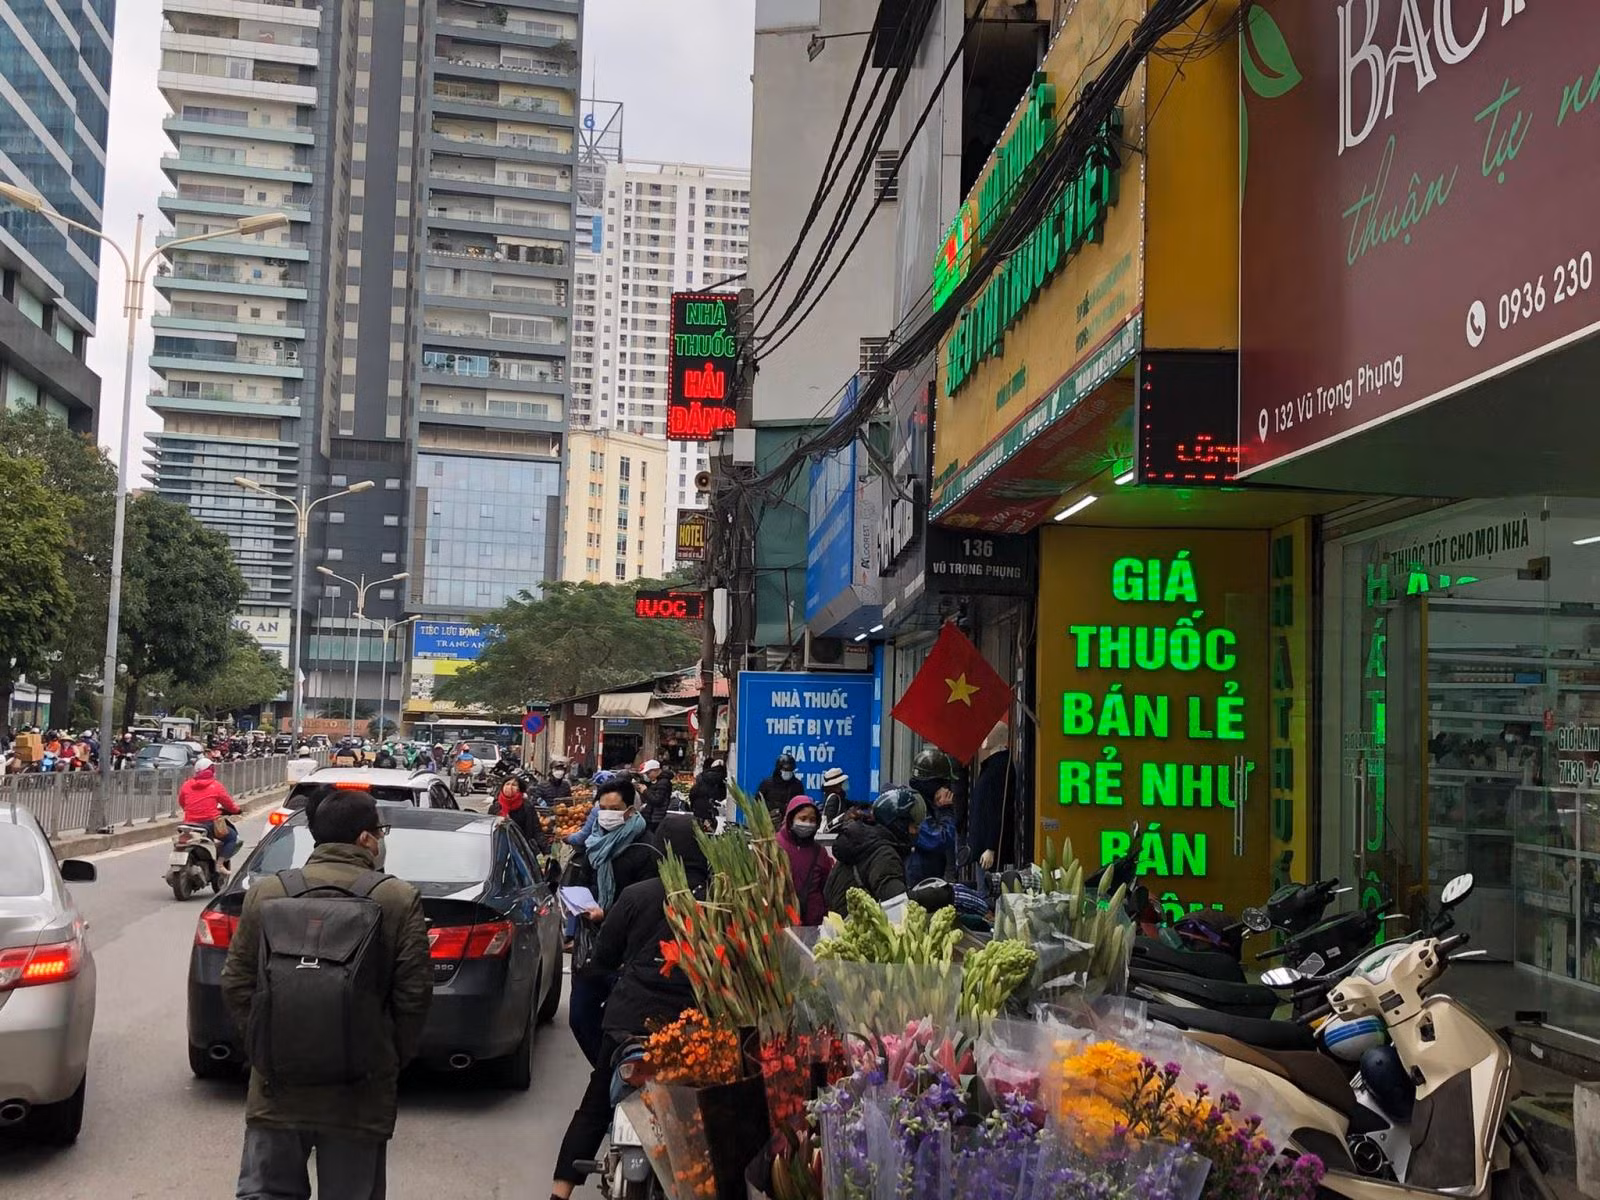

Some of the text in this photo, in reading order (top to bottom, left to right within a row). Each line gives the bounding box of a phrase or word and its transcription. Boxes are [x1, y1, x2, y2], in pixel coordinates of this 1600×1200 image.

[1337, 0, 1525, 156] BAC
[1343, 135, 1458, 265] thuận
[1499, 251, 1593, 329] 0936 230
[685, 300, 728, 326] NHÀ
[674, 328, 736, 357] THUỐC
[685, 362, 725, 398] HẢI
[1275, 354, 1403, 433] 132 Vũ Trọng Phụng
[671, 402, 736, 435] ĐĂNG
[678, 524, 705, 547] HOTEL
[962, 539, 993, 557] 136
[1391, 511, 1529, 576] THUỐC TỐT CHO MỌI NHÀ
[949, 563, 983, 576] TRỌNG
[985, 565, 1021, 580] PHỤNG
[1112, 550, 1198, 602] GIÁ
[1070, 610, 1236, 671] THUỐC
[772, 688, 848, 709] NHÀ THUỐC
[1063, 681, 1245, 740] BÁN LẺ
[766, 714, 856, 740] THIẾT BỊ Y TẾ
[1576, 721, 1600, 751] LÀM
[808, 741, 836, 763] TỐT
[1059, 746, 1255, 808] RẺ NHƯ
[1558, 759, 1585, 784] 7H30
[1100, 822, 1207, 876] BÁN
